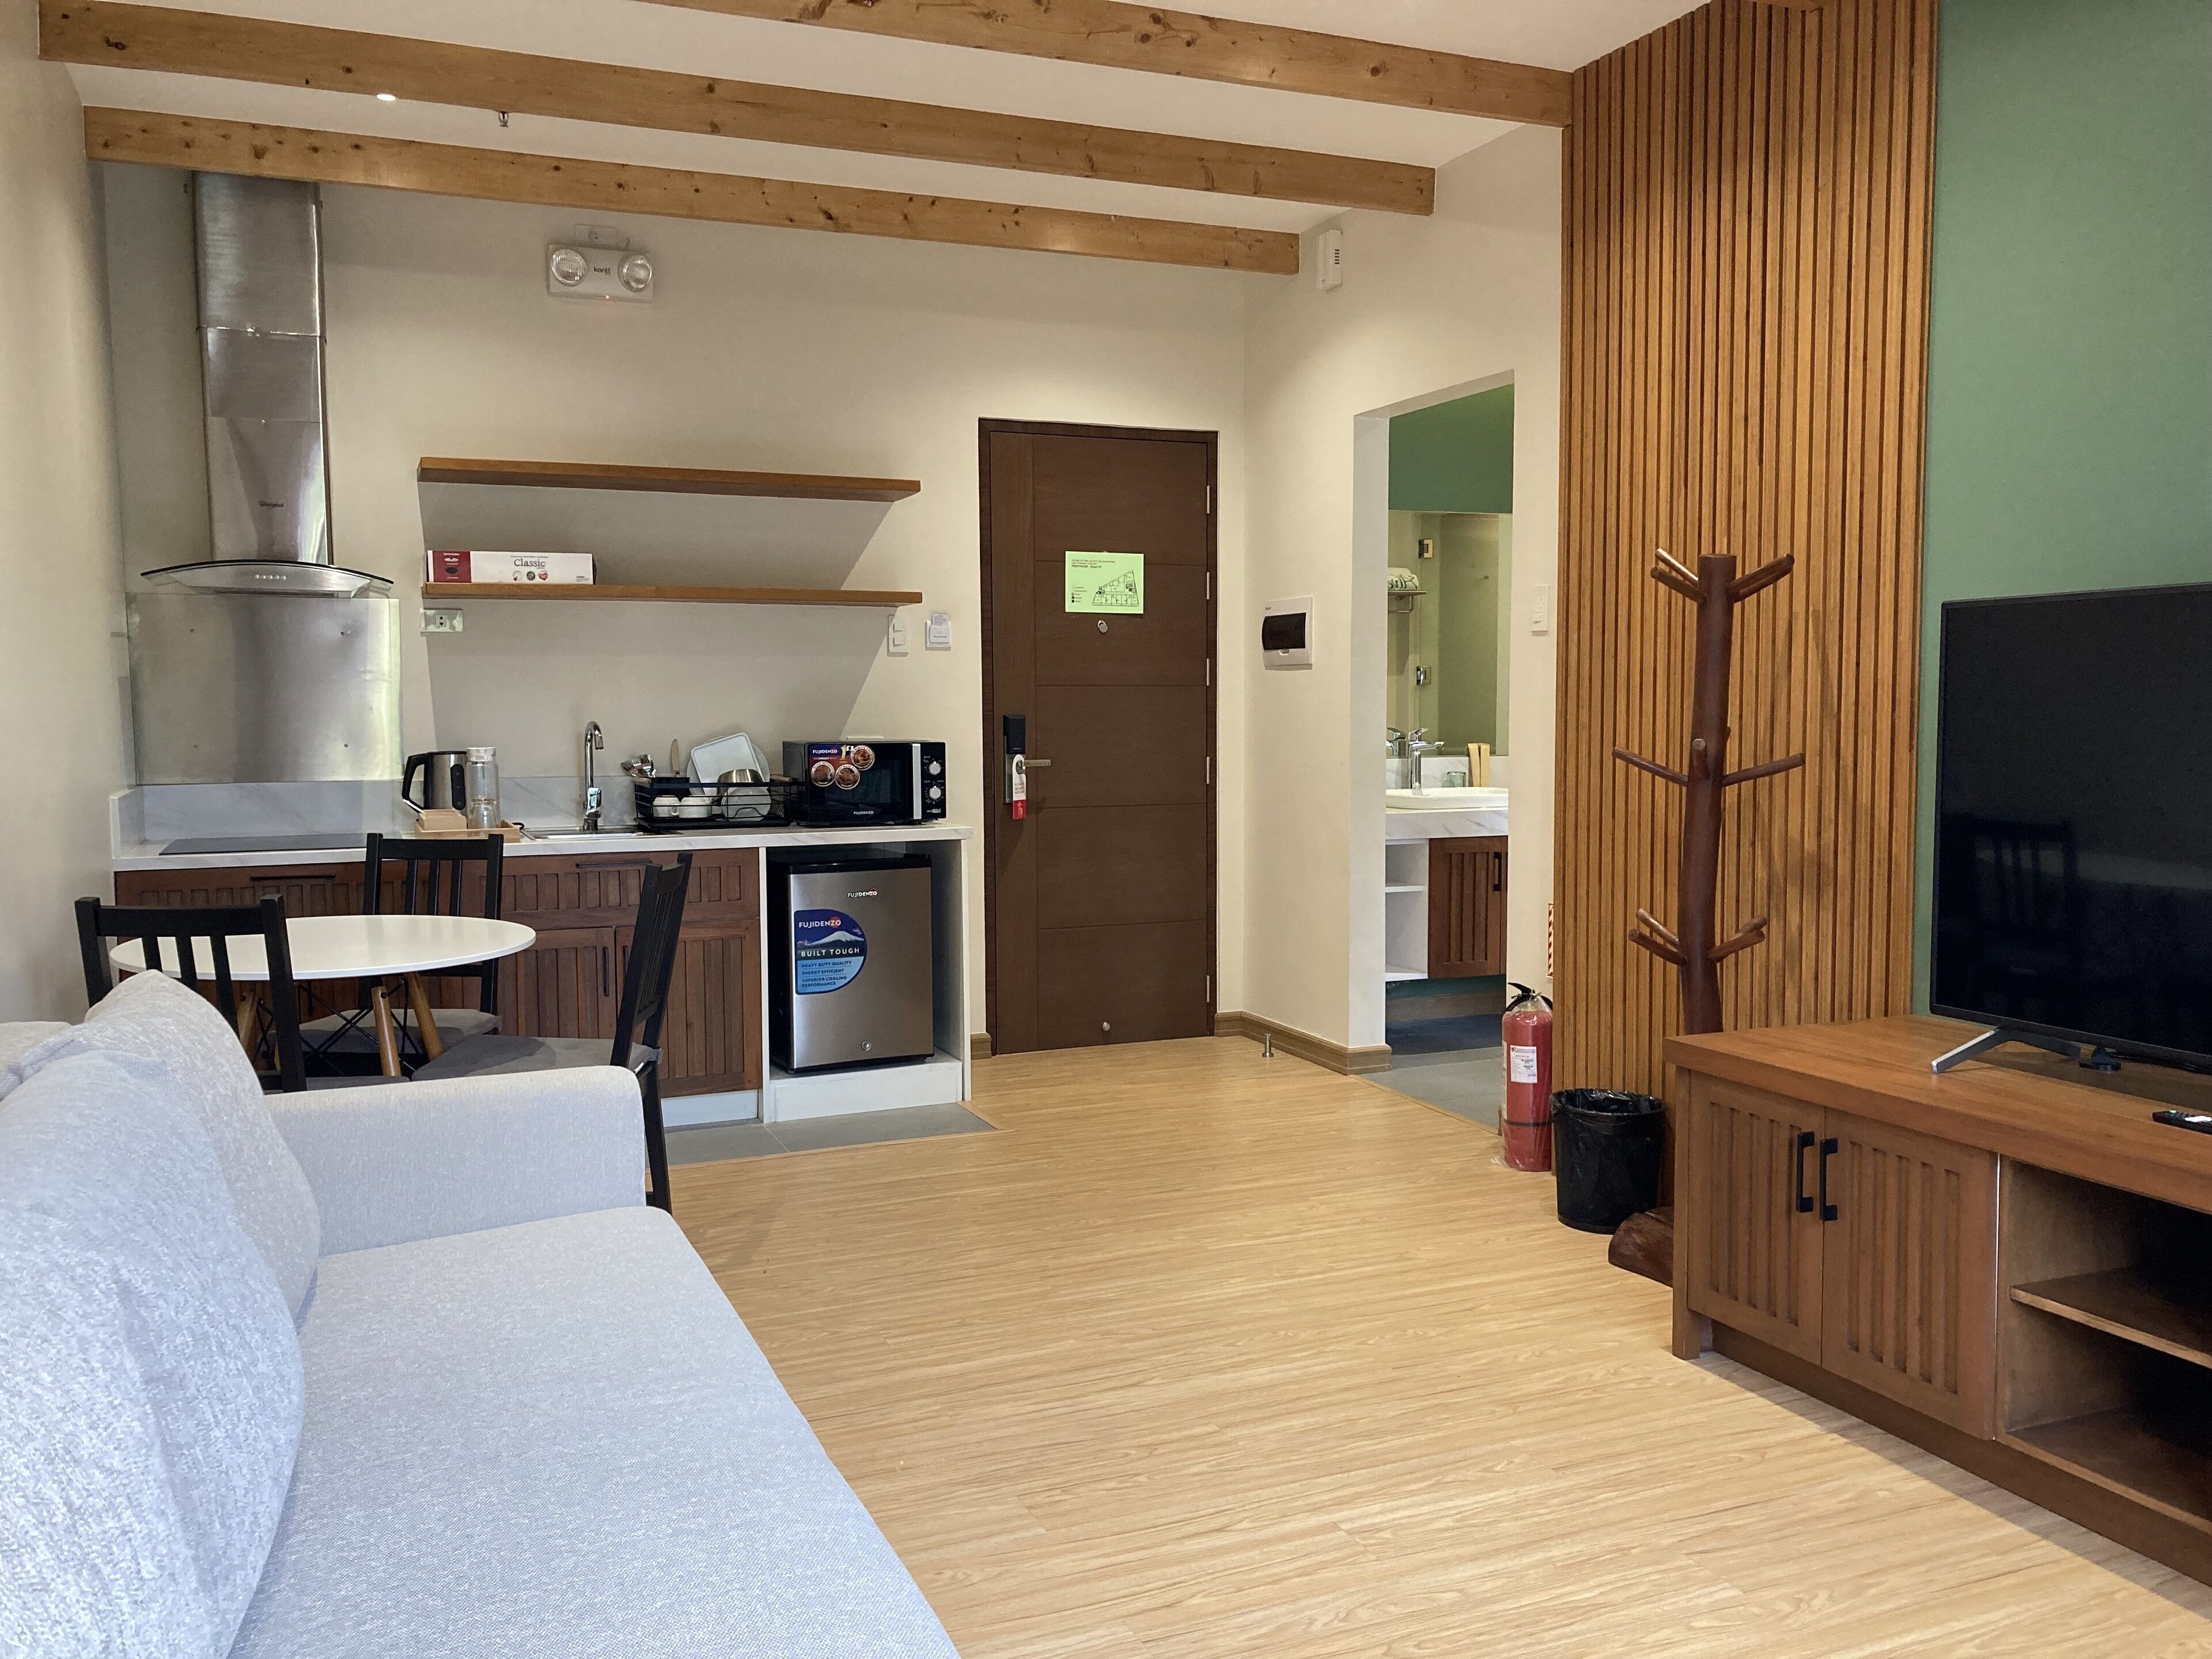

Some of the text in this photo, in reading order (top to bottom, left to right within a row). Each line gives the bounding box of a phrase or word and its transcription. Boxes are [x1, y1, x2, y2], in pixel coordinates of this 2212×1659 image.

[514, 558, 546, 567] Classic
[798, 919, 842, 929] FUJIDENZO
[830, 948, 859, 956] TOUGH
